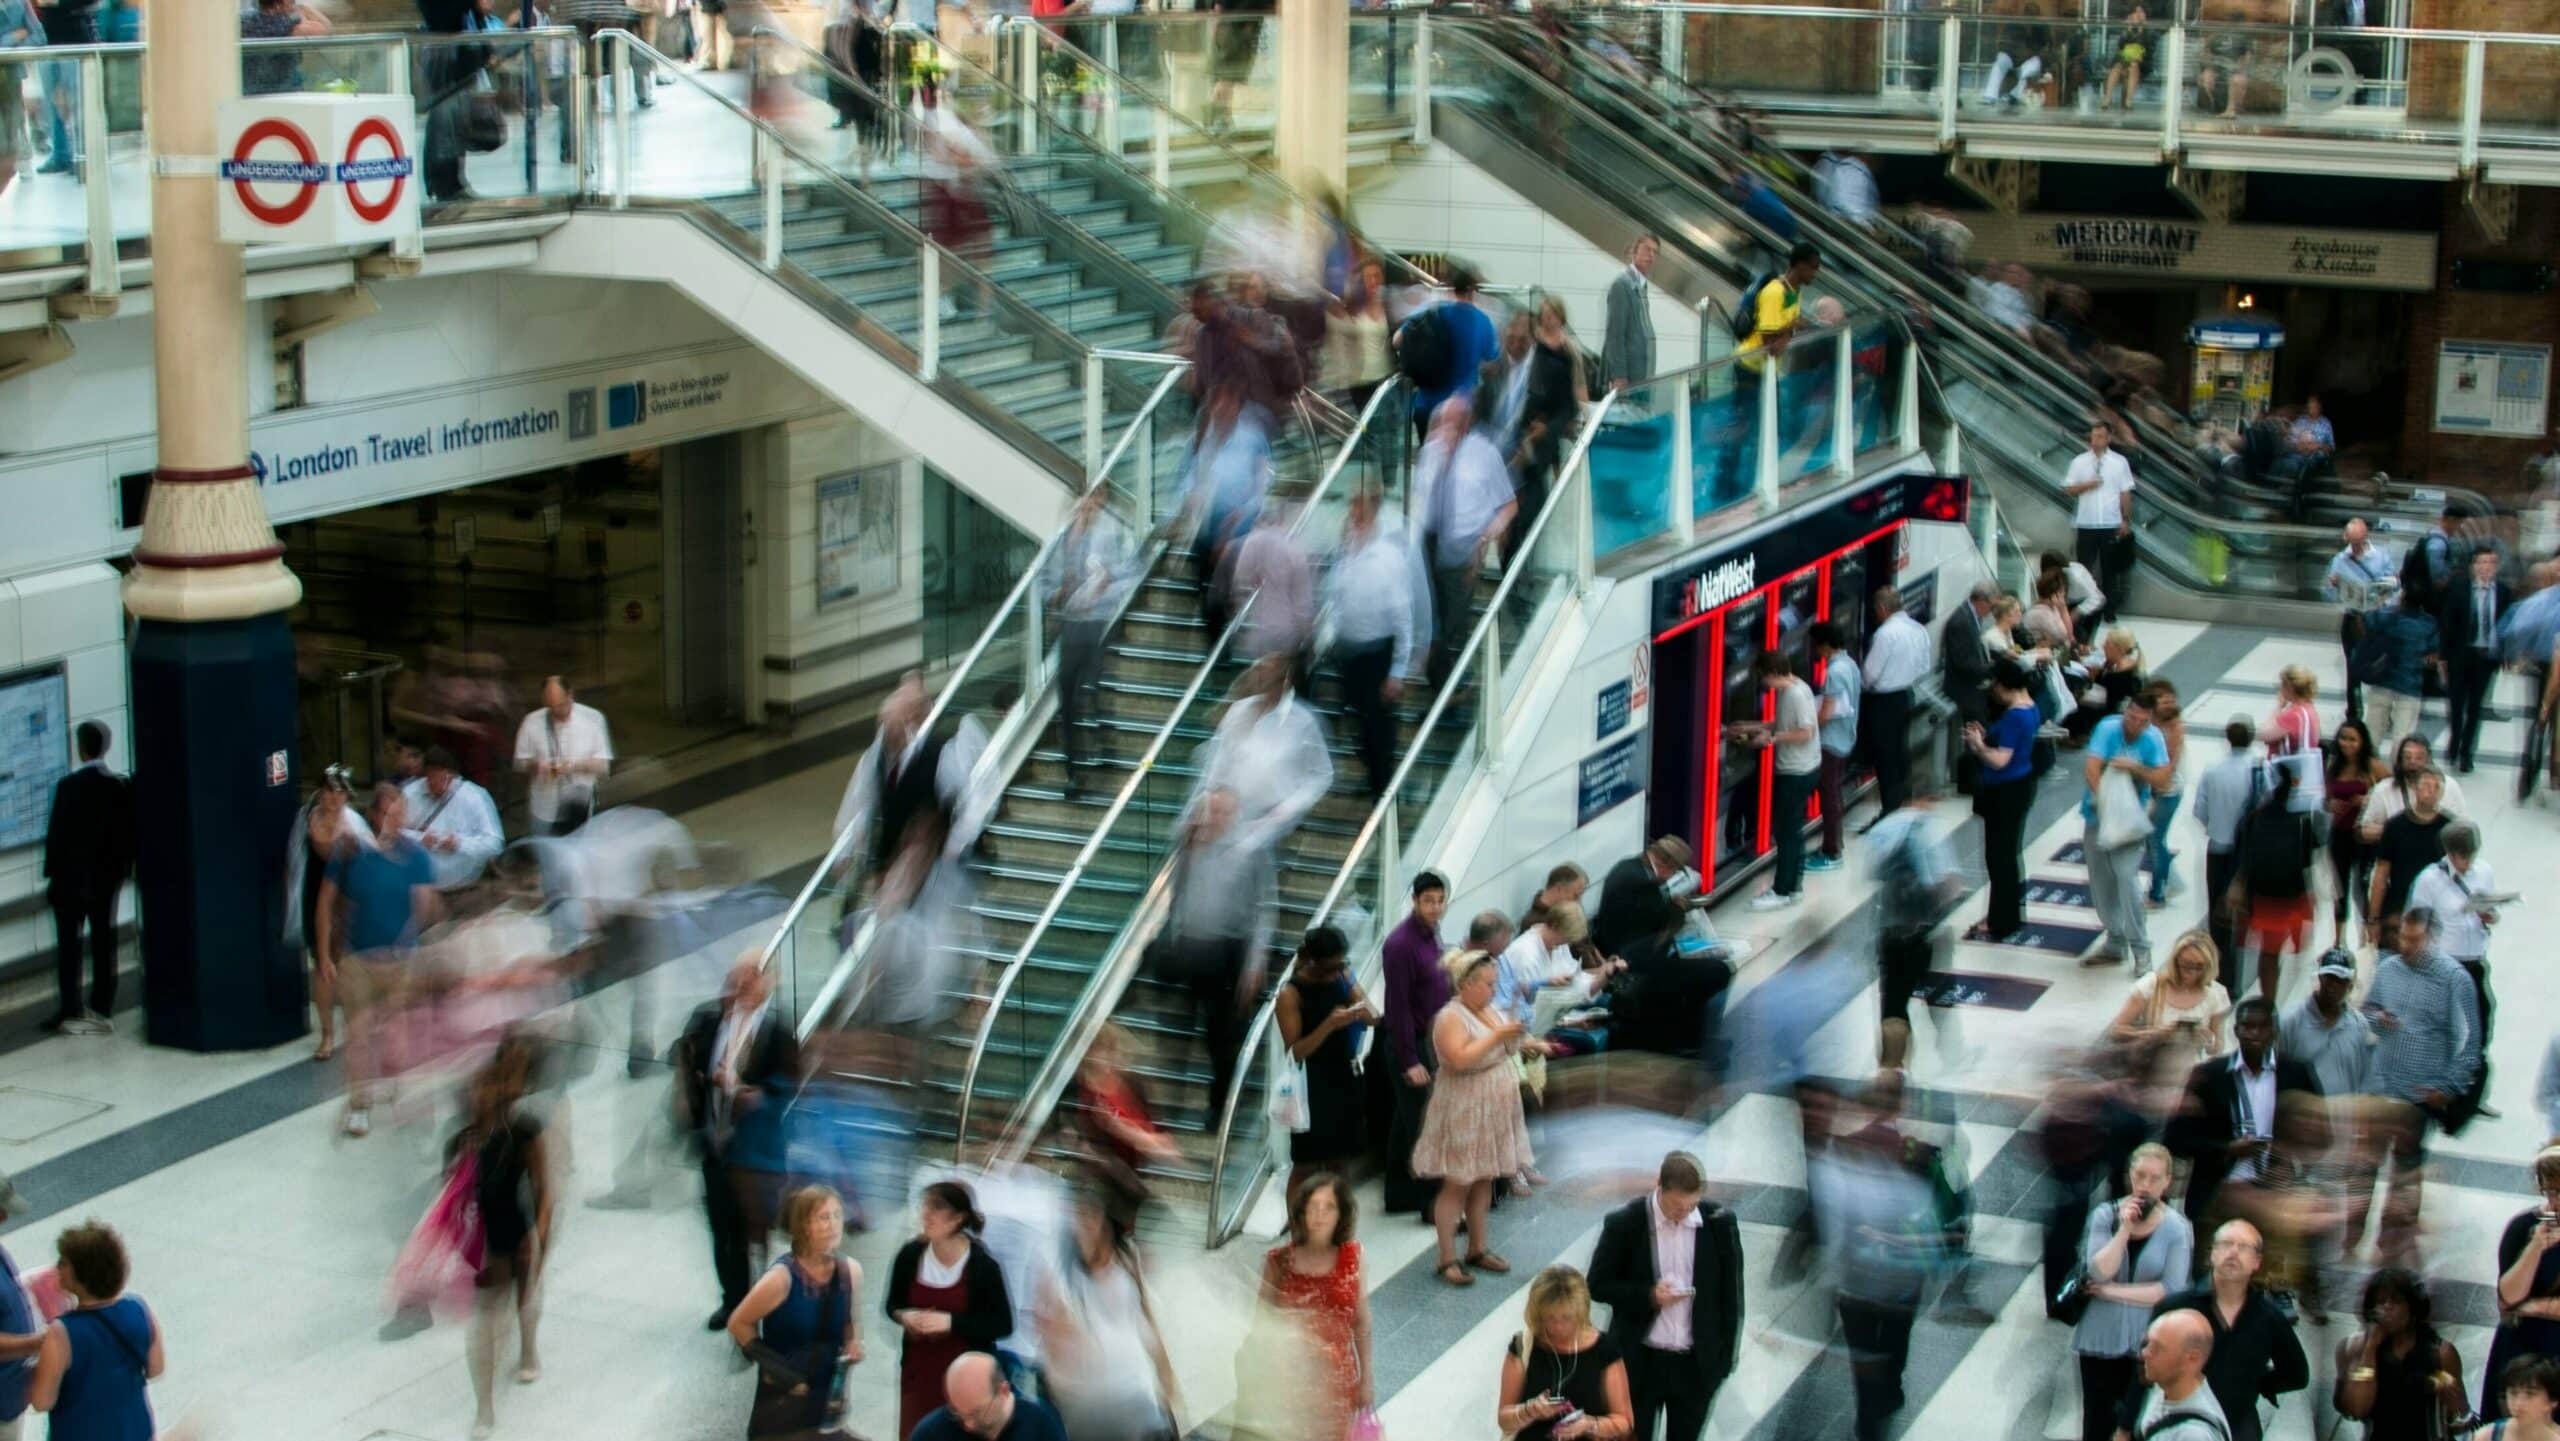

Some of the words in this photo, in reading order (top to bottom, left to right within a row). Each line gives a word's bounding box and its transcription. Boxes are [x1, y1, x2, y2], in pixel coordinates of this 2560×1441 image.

[228, 162, 324, 179] UNDERGROUND
[341, 160, 410, 178] UNDERGROUND
[2055, 220, 2200, 252] MERCHANT
[2073, 249, 2180, 267] BISHOPSGATE
[275, 445, 359, 483] London
[367, 427, 433, 463] Travel
[443, 407, 560, 451] Information
[1700, 551, 1756, 612] NatWest
